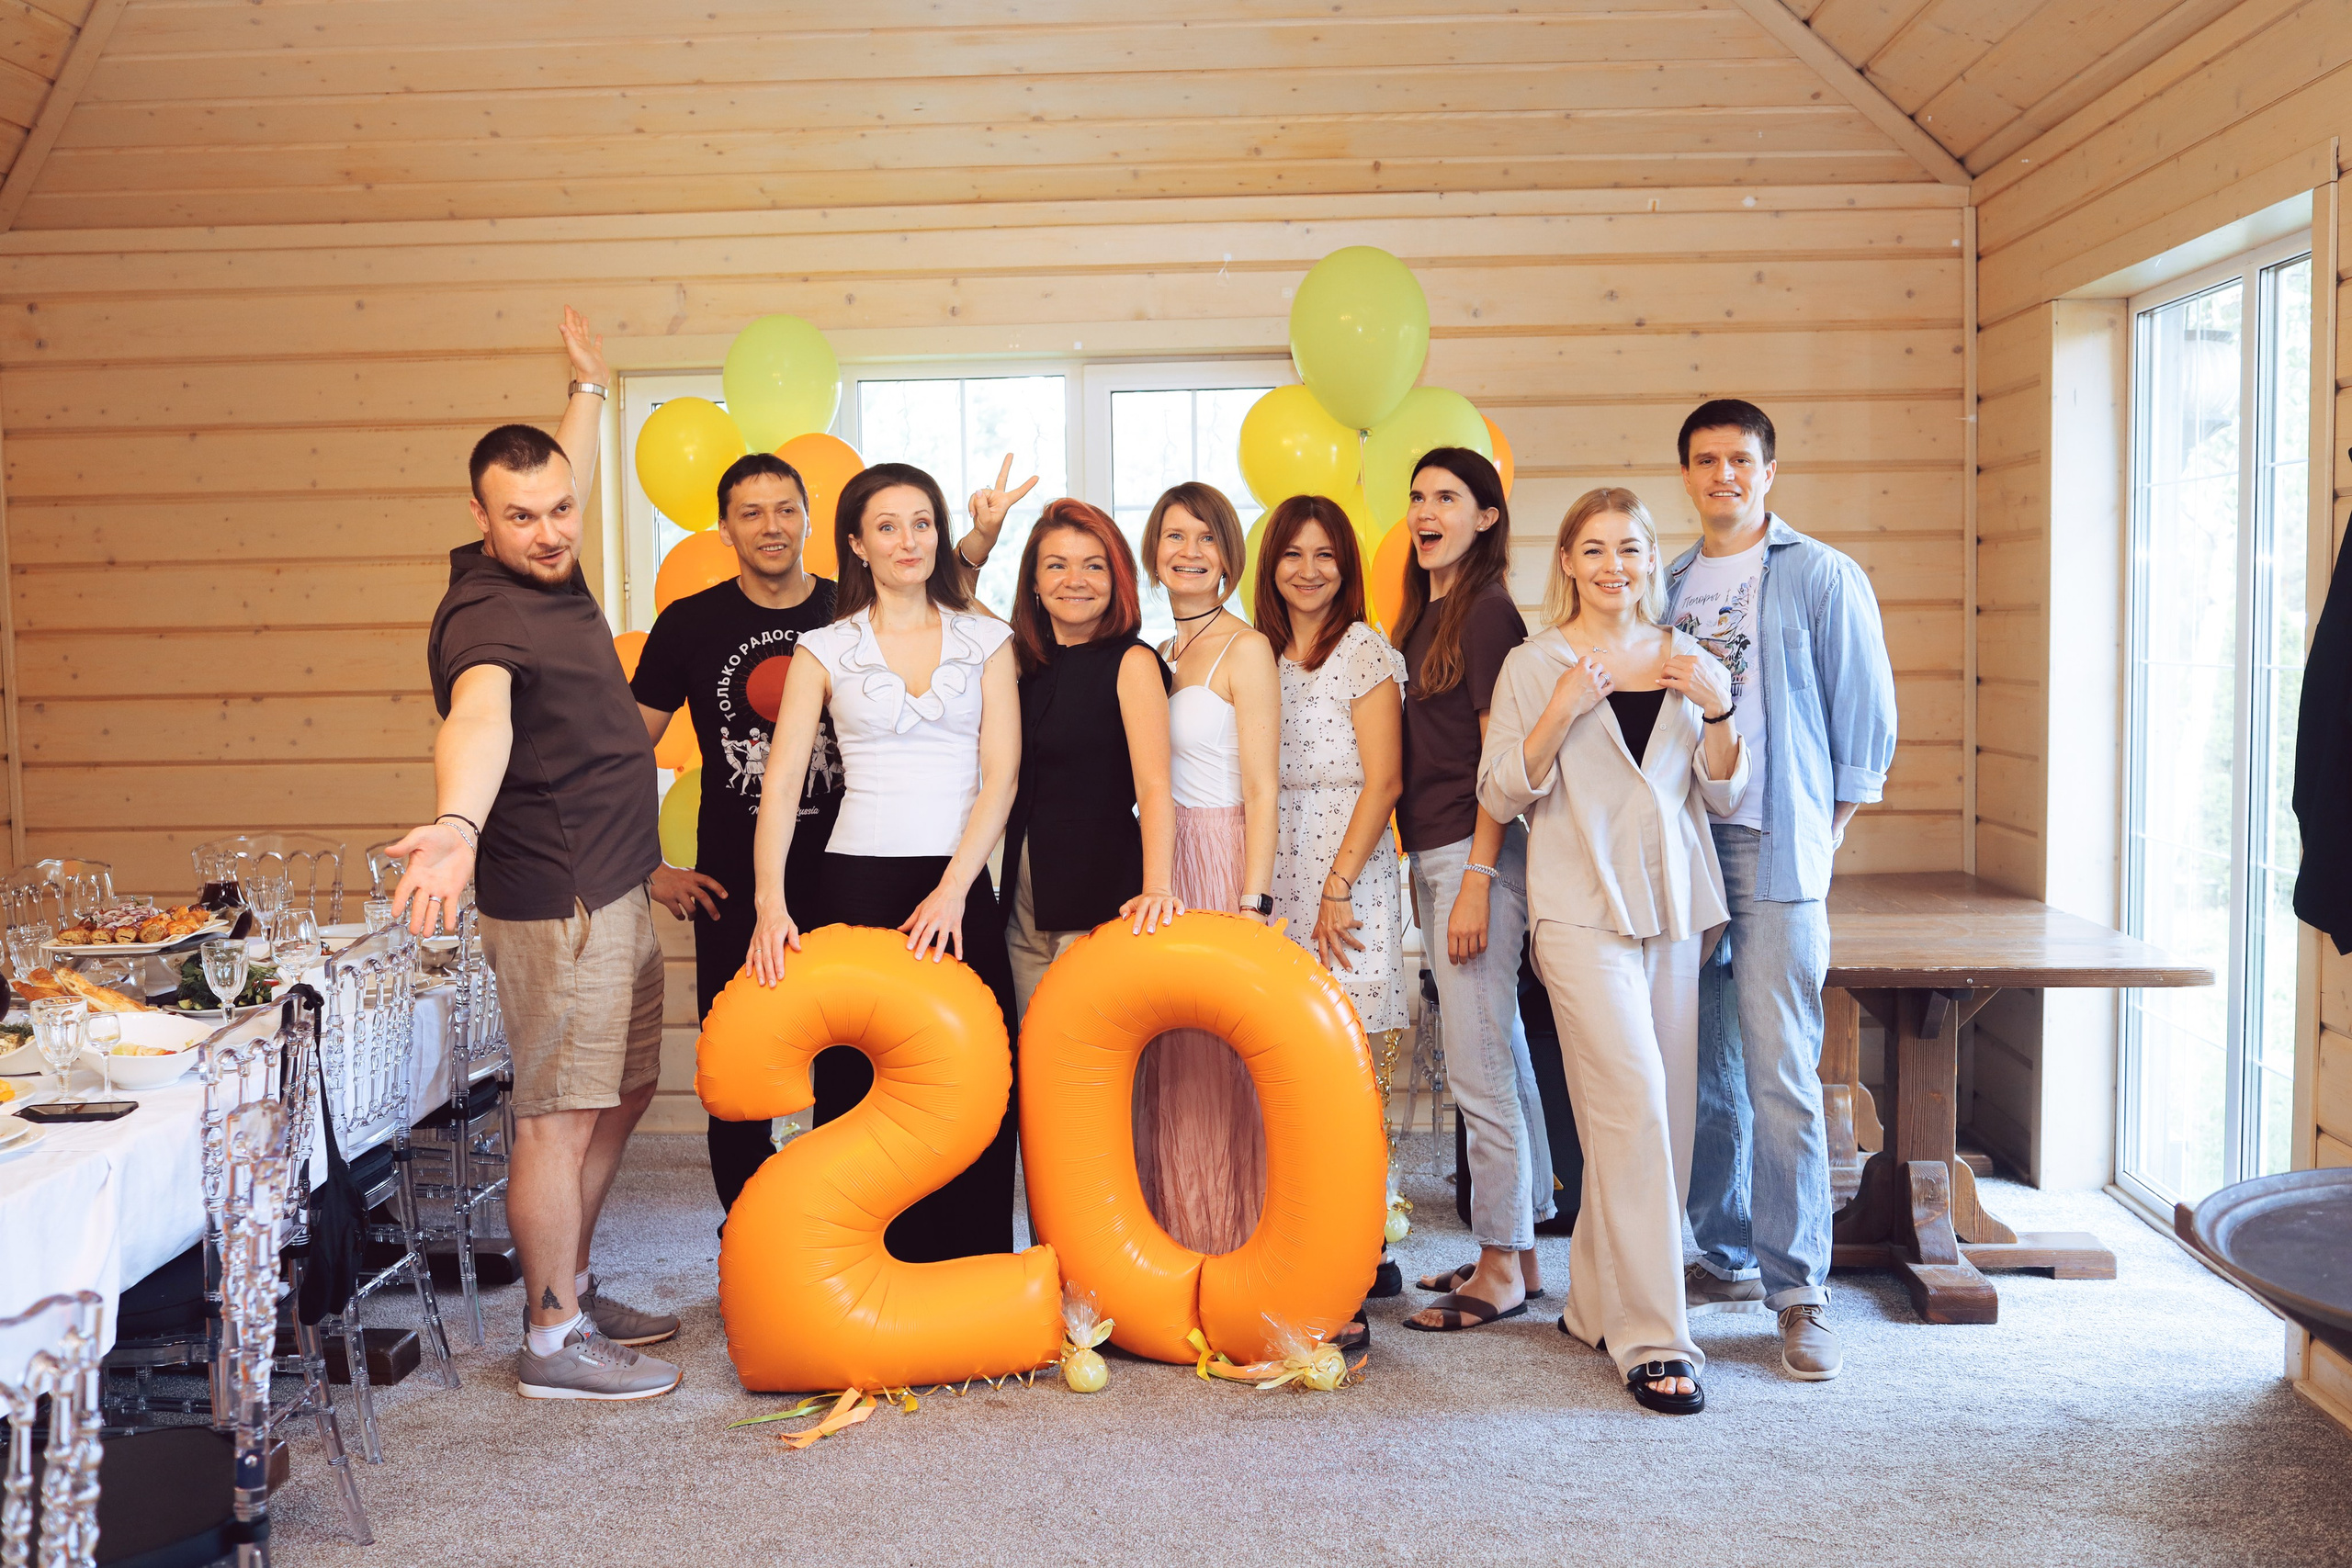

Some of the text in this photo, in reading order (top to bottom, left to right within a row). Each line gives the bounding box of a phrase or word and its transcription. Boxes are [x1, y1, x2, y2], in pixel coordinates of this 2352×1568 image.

[717, 629, 805, 722] ТОЛЬКО РАДОСТ
[694, 908, 1388, 1393] 20
